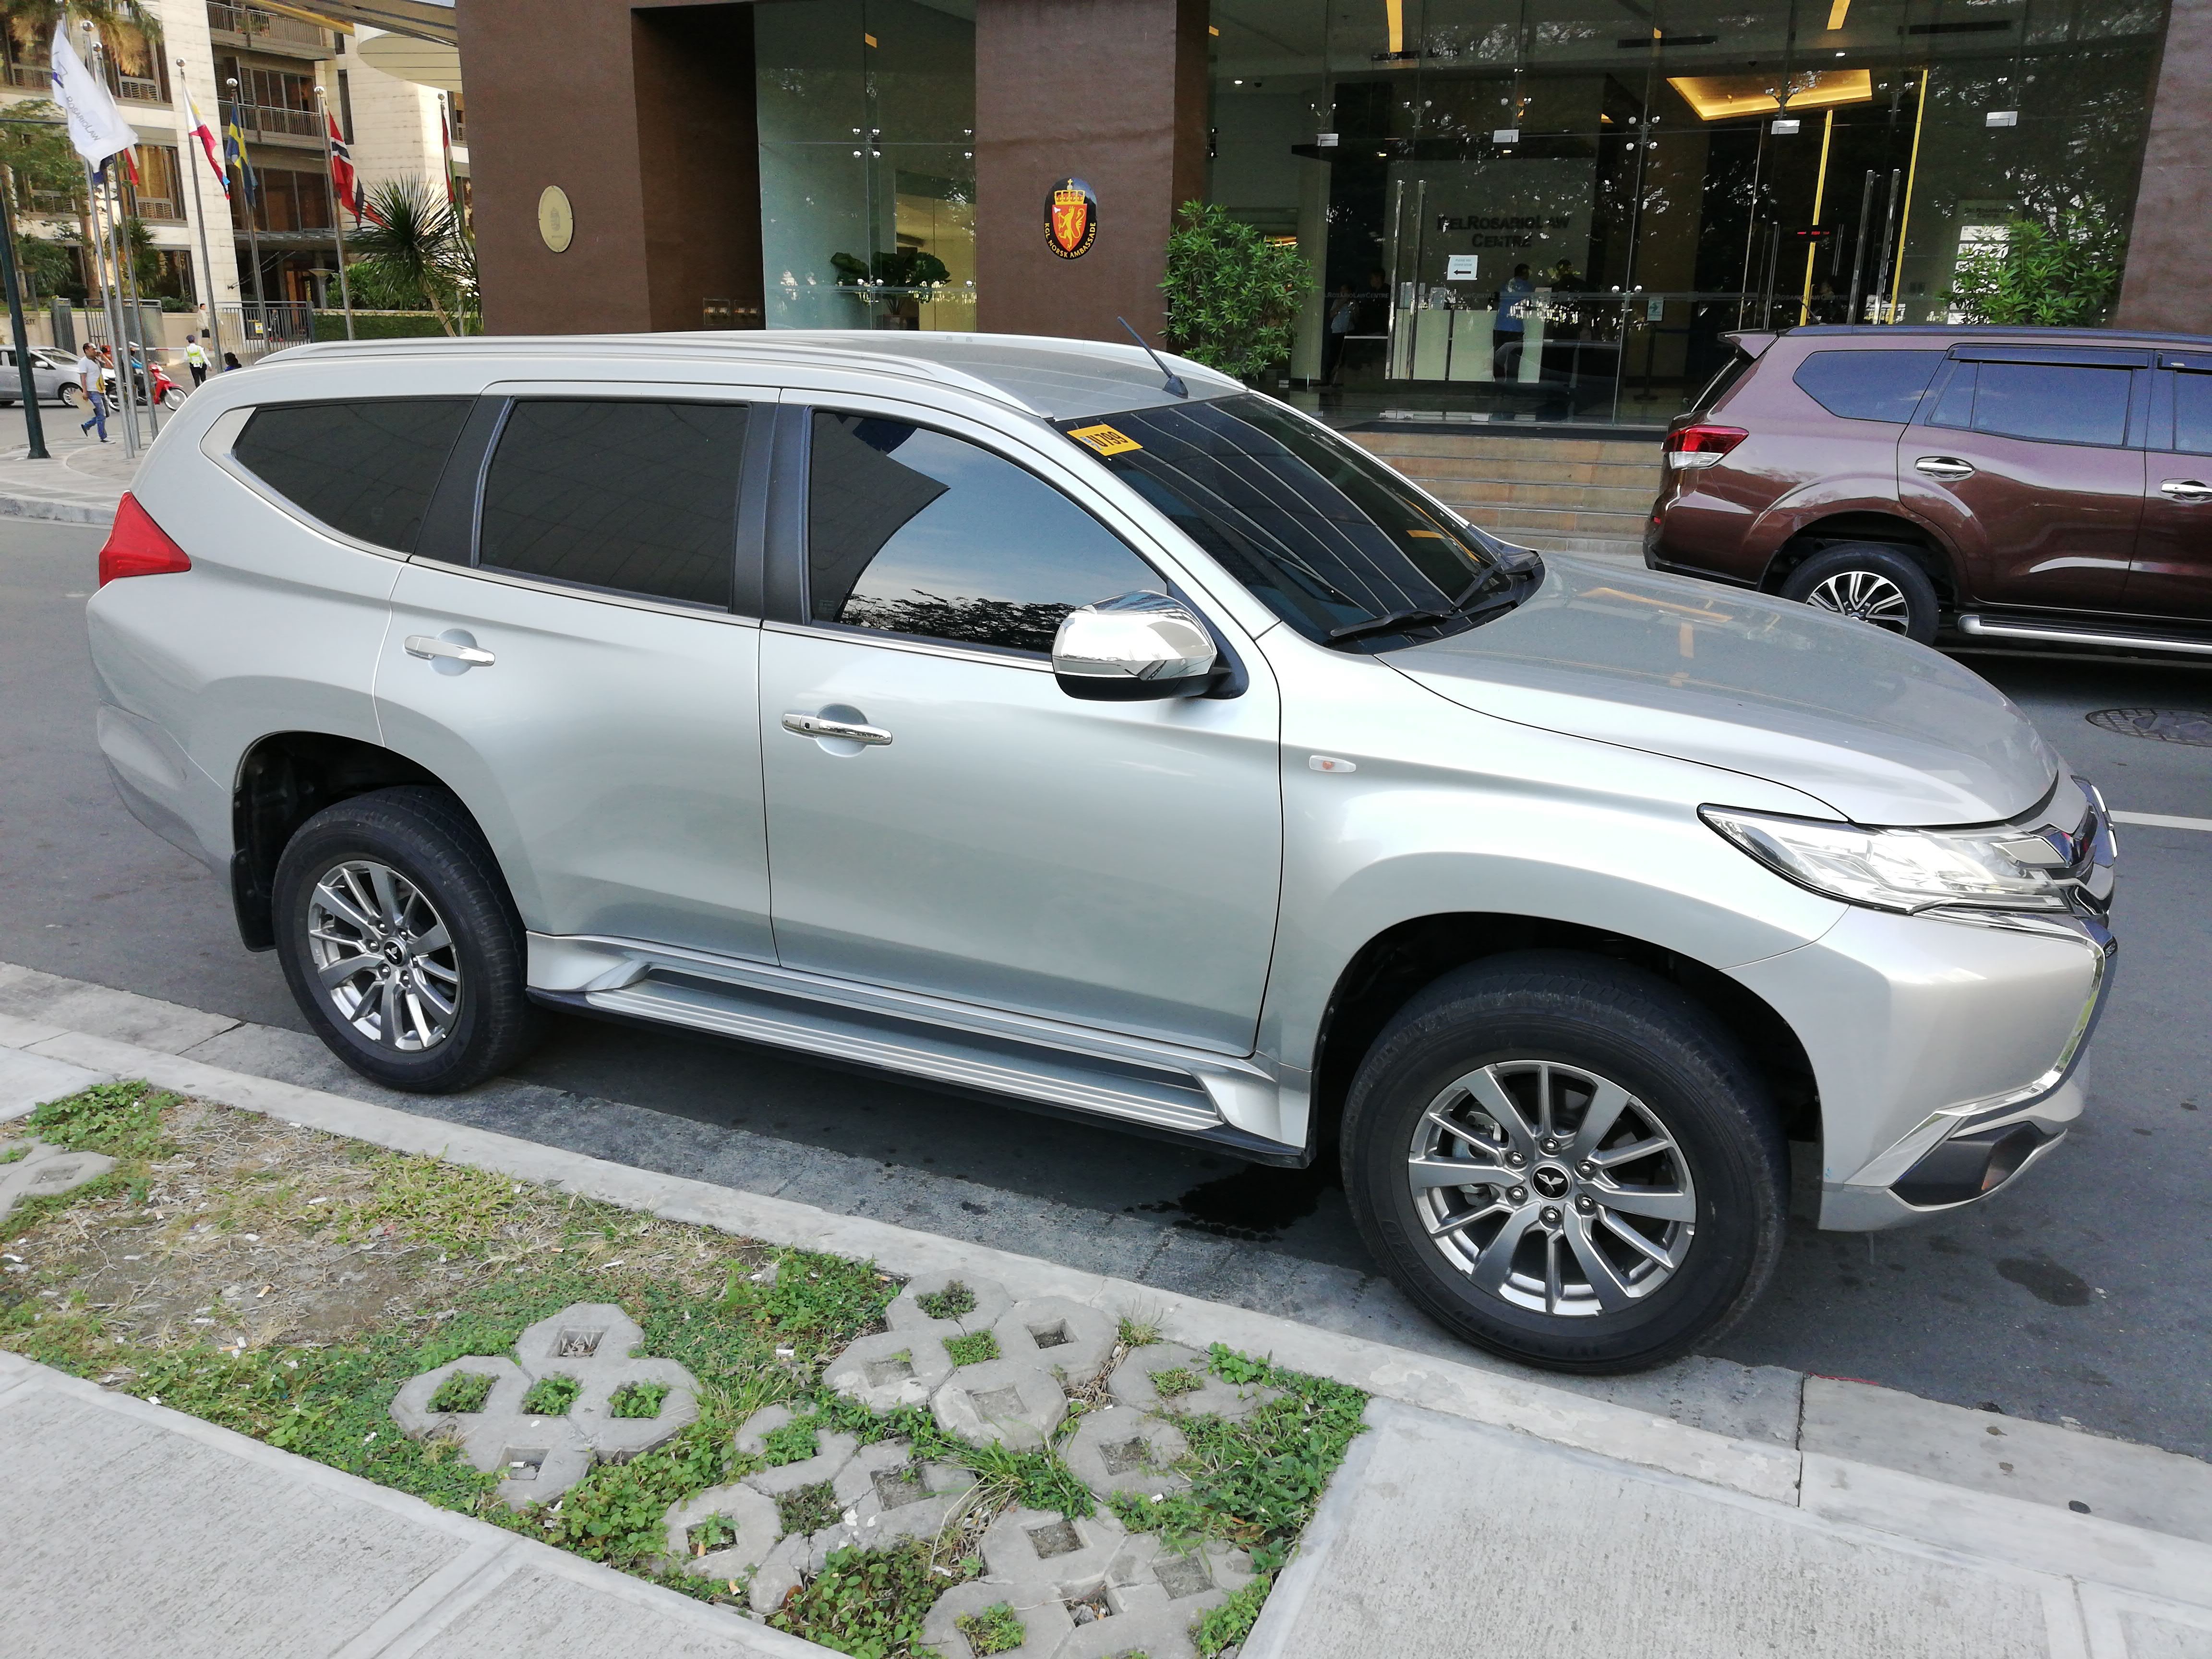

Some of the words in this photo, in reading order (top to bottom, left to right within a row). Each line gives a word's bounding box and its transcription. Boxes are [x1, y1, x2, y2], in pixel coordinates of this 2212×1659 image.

[1048, 240, 1068, 258] NORSK
[1070, 222, 1096, 258] AMBASSADE
[1086, 431, 1129, 447] U799
